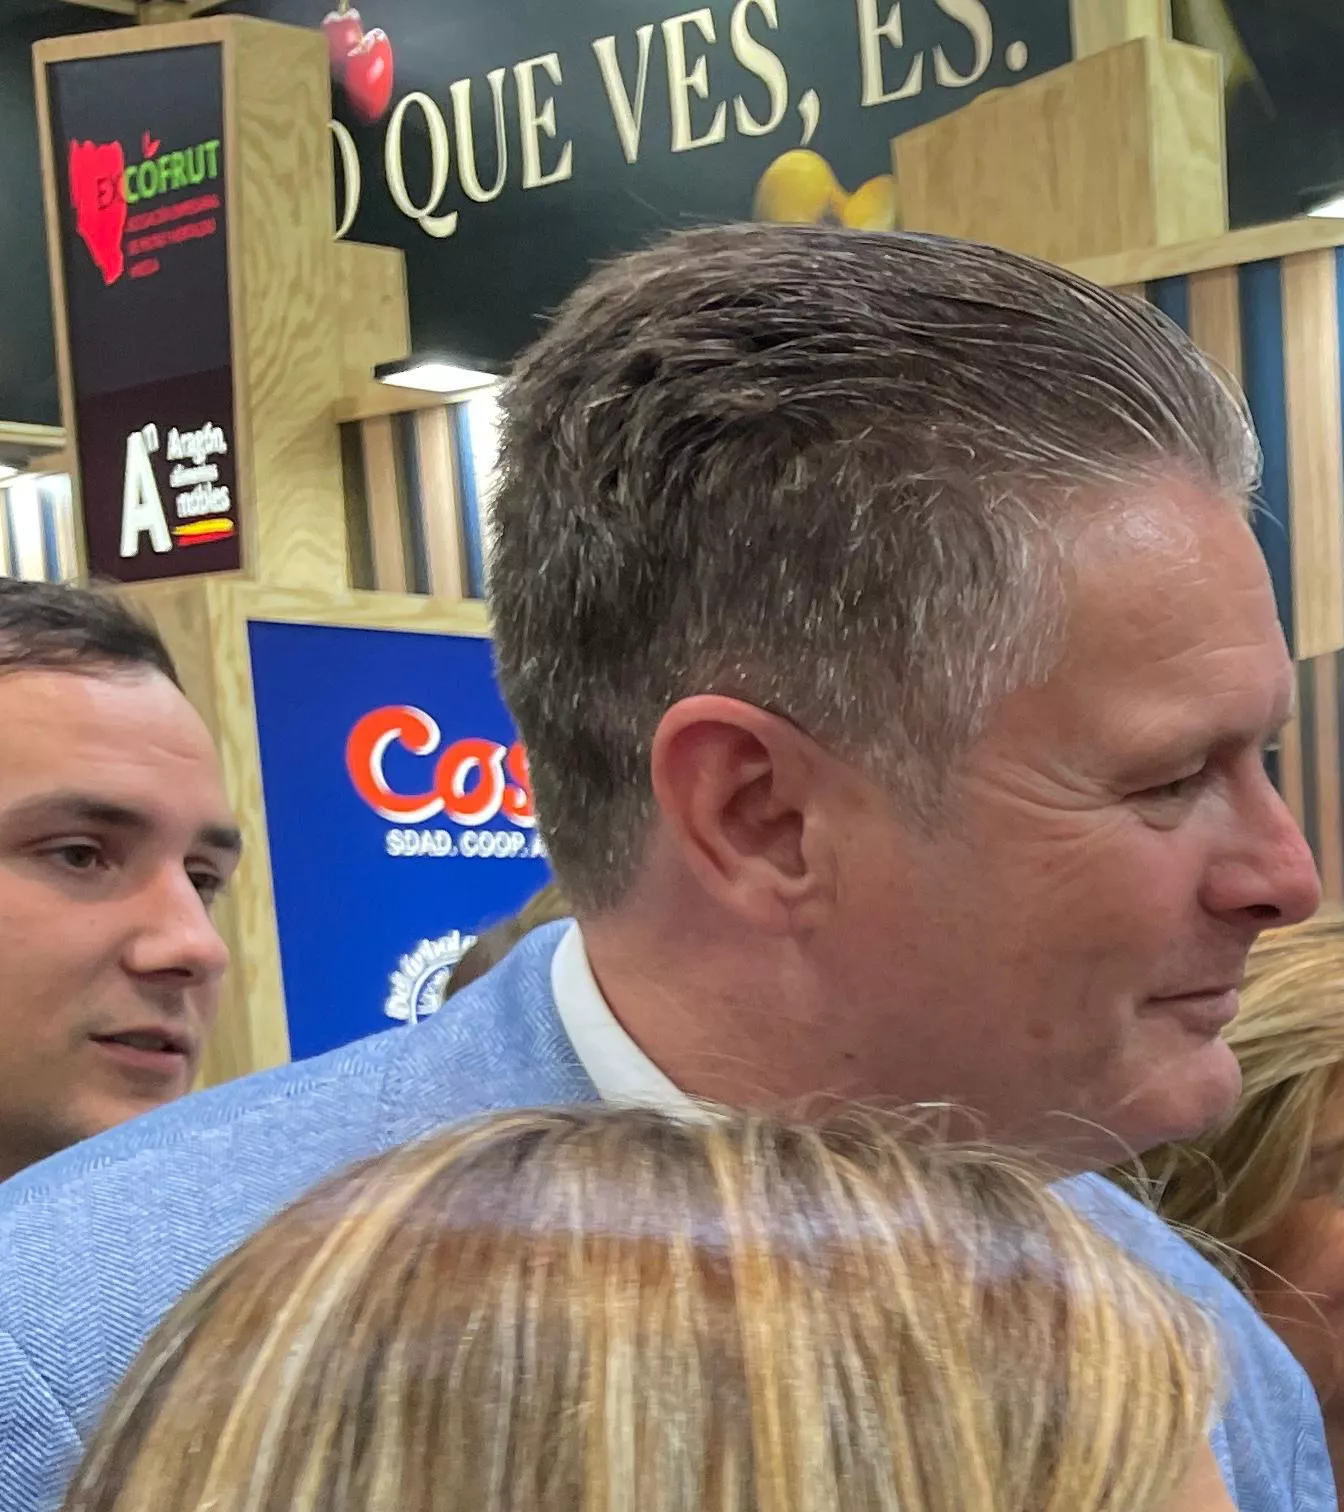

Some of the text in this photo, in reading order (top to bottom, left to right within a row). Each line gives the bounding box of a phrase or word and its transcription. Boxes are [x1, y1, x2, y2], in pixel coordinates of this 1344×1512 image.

[384, 53, 574, 239] QUE
[592, 0, 820, 165] VES,
[385, 828, 459, 857] SDAD.
[459, 829, 530, 859] COOP.
